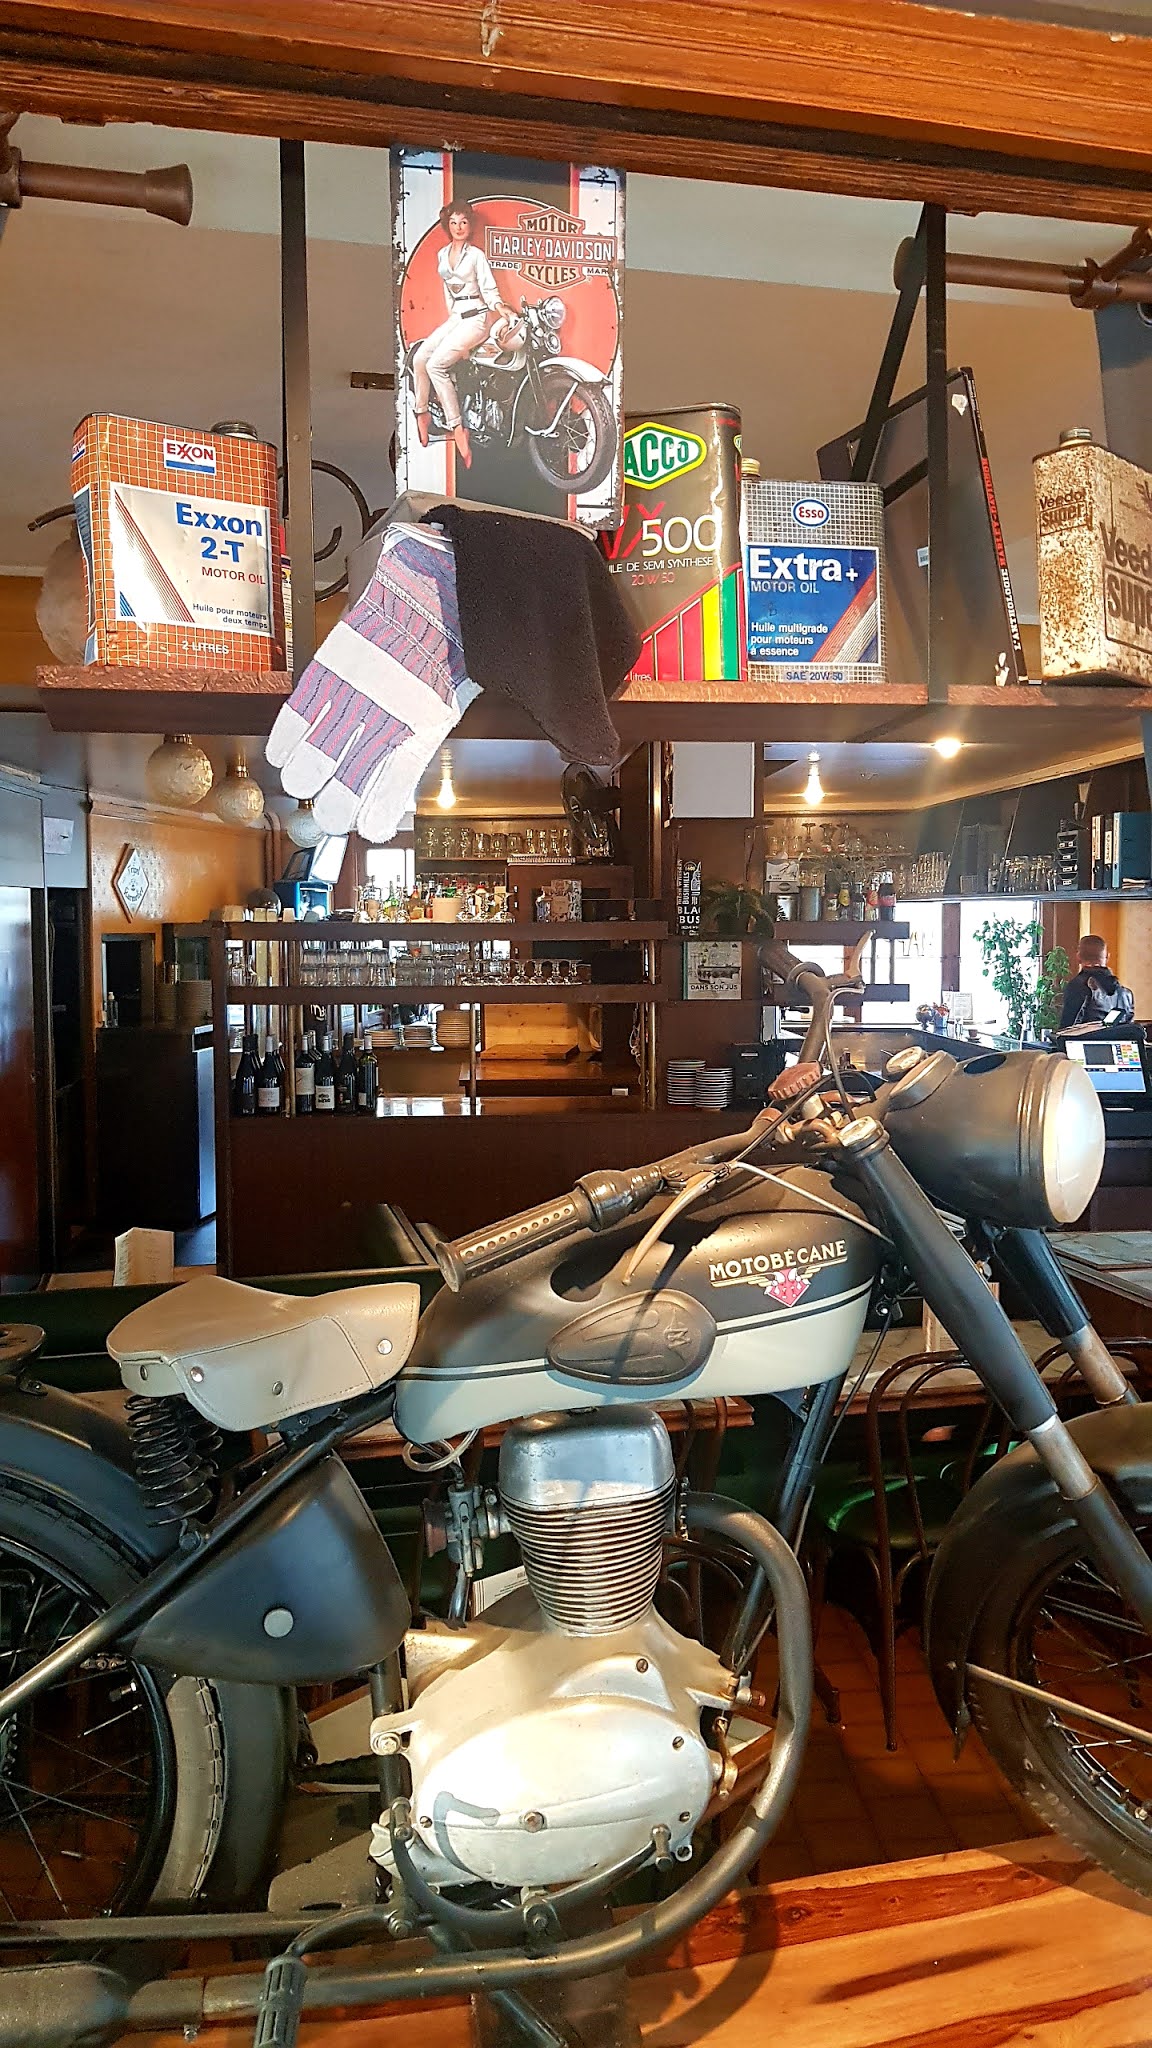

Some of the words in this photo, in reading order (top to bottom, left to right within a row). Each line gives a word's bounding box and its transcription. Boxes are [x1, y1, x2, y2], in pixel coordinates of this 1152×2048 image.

[526, 214, 578, 233] MOTOR
[493, 235, 612, 261] HARLEY-DAVIDSON
[491, 261, 519, 269] TRADE
[528, 265, 577, 285] CYCLES
[166, 442, 215, 462] EXXON
[176, 501, 263, 537] Exxon
[798, 507, 825, 519] Esso
[642, 513, 722, 558] 500
[201, 536, 245, 563] 2-T
[627, 561, 640, 573] DE
[643, 560, 665, 571] SEMI
[667, 556, 713, 569] SYNTHESE
[201, 566, 245, 582] MOTOR
[248, 573, 266, 585] OIL
[632, 574, 645, 586] 20
[751, 581, 796, 593] MOTOR
[800, 582, 819, 594] OIL
[193, 602, 214, 613] Huile
[216, 606, 235, 616] pour
[236, 609, 267, 621] moteurs
[222, 615, 243, 625] deux
[244, 618, 268, 629] temps
[751, 622, 775, 633] Huile
[778, 622, 828, 636] multigrade
[181, 640, 190, 651] 2
[192, 641, 230, 655] LITRES
[750, 635, 773, 647] pour
[775, 636, 814, 646] moteurs
[759, 646, 799, 656] essence
[786, 671, 807, 681] SAE
[678, 906, 701, 915] BLA
